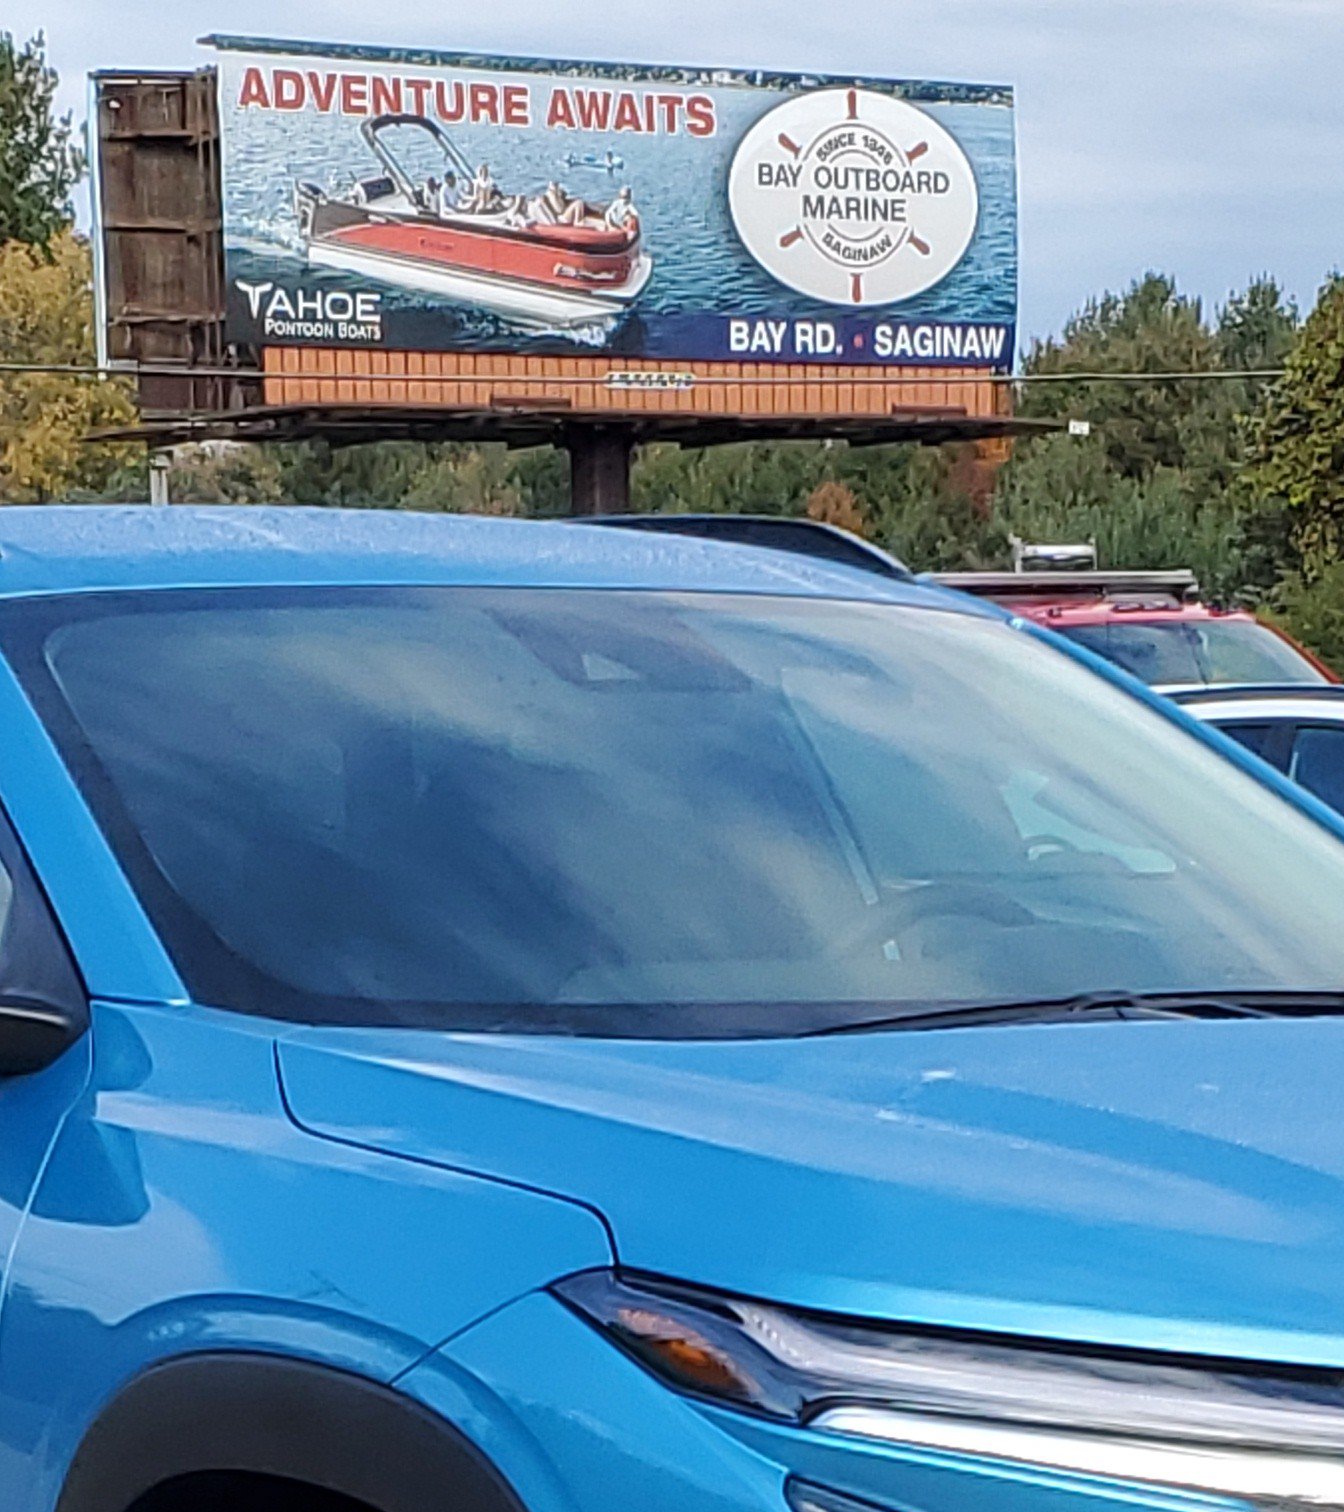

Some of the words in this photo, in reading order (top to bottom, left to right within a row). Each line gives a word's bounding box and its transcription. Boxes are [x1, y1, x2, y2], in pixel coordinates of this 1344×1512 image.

[239, 67, 529, 125] ADVENTURE
[548, 88, 716, 136] AWAITS
[816, 132, 856, 162] SINCE
[758, 163, 803, 187] BAY
[814, 166, 951, 194] OUTBOARD
[802, 195, 907, 222] MARINE
[822, 232, 893, 261] SAGINAW
[234, 279, 381, 322] TAHOE
[264, 317, 334, 338] PONTOON
[338, 321, 382, 341] BOATS
[729, 320, 787, 353] BAY
[794, 322, 843, 356] RD.
[874, 324, 1006, 359] SAGINAW
